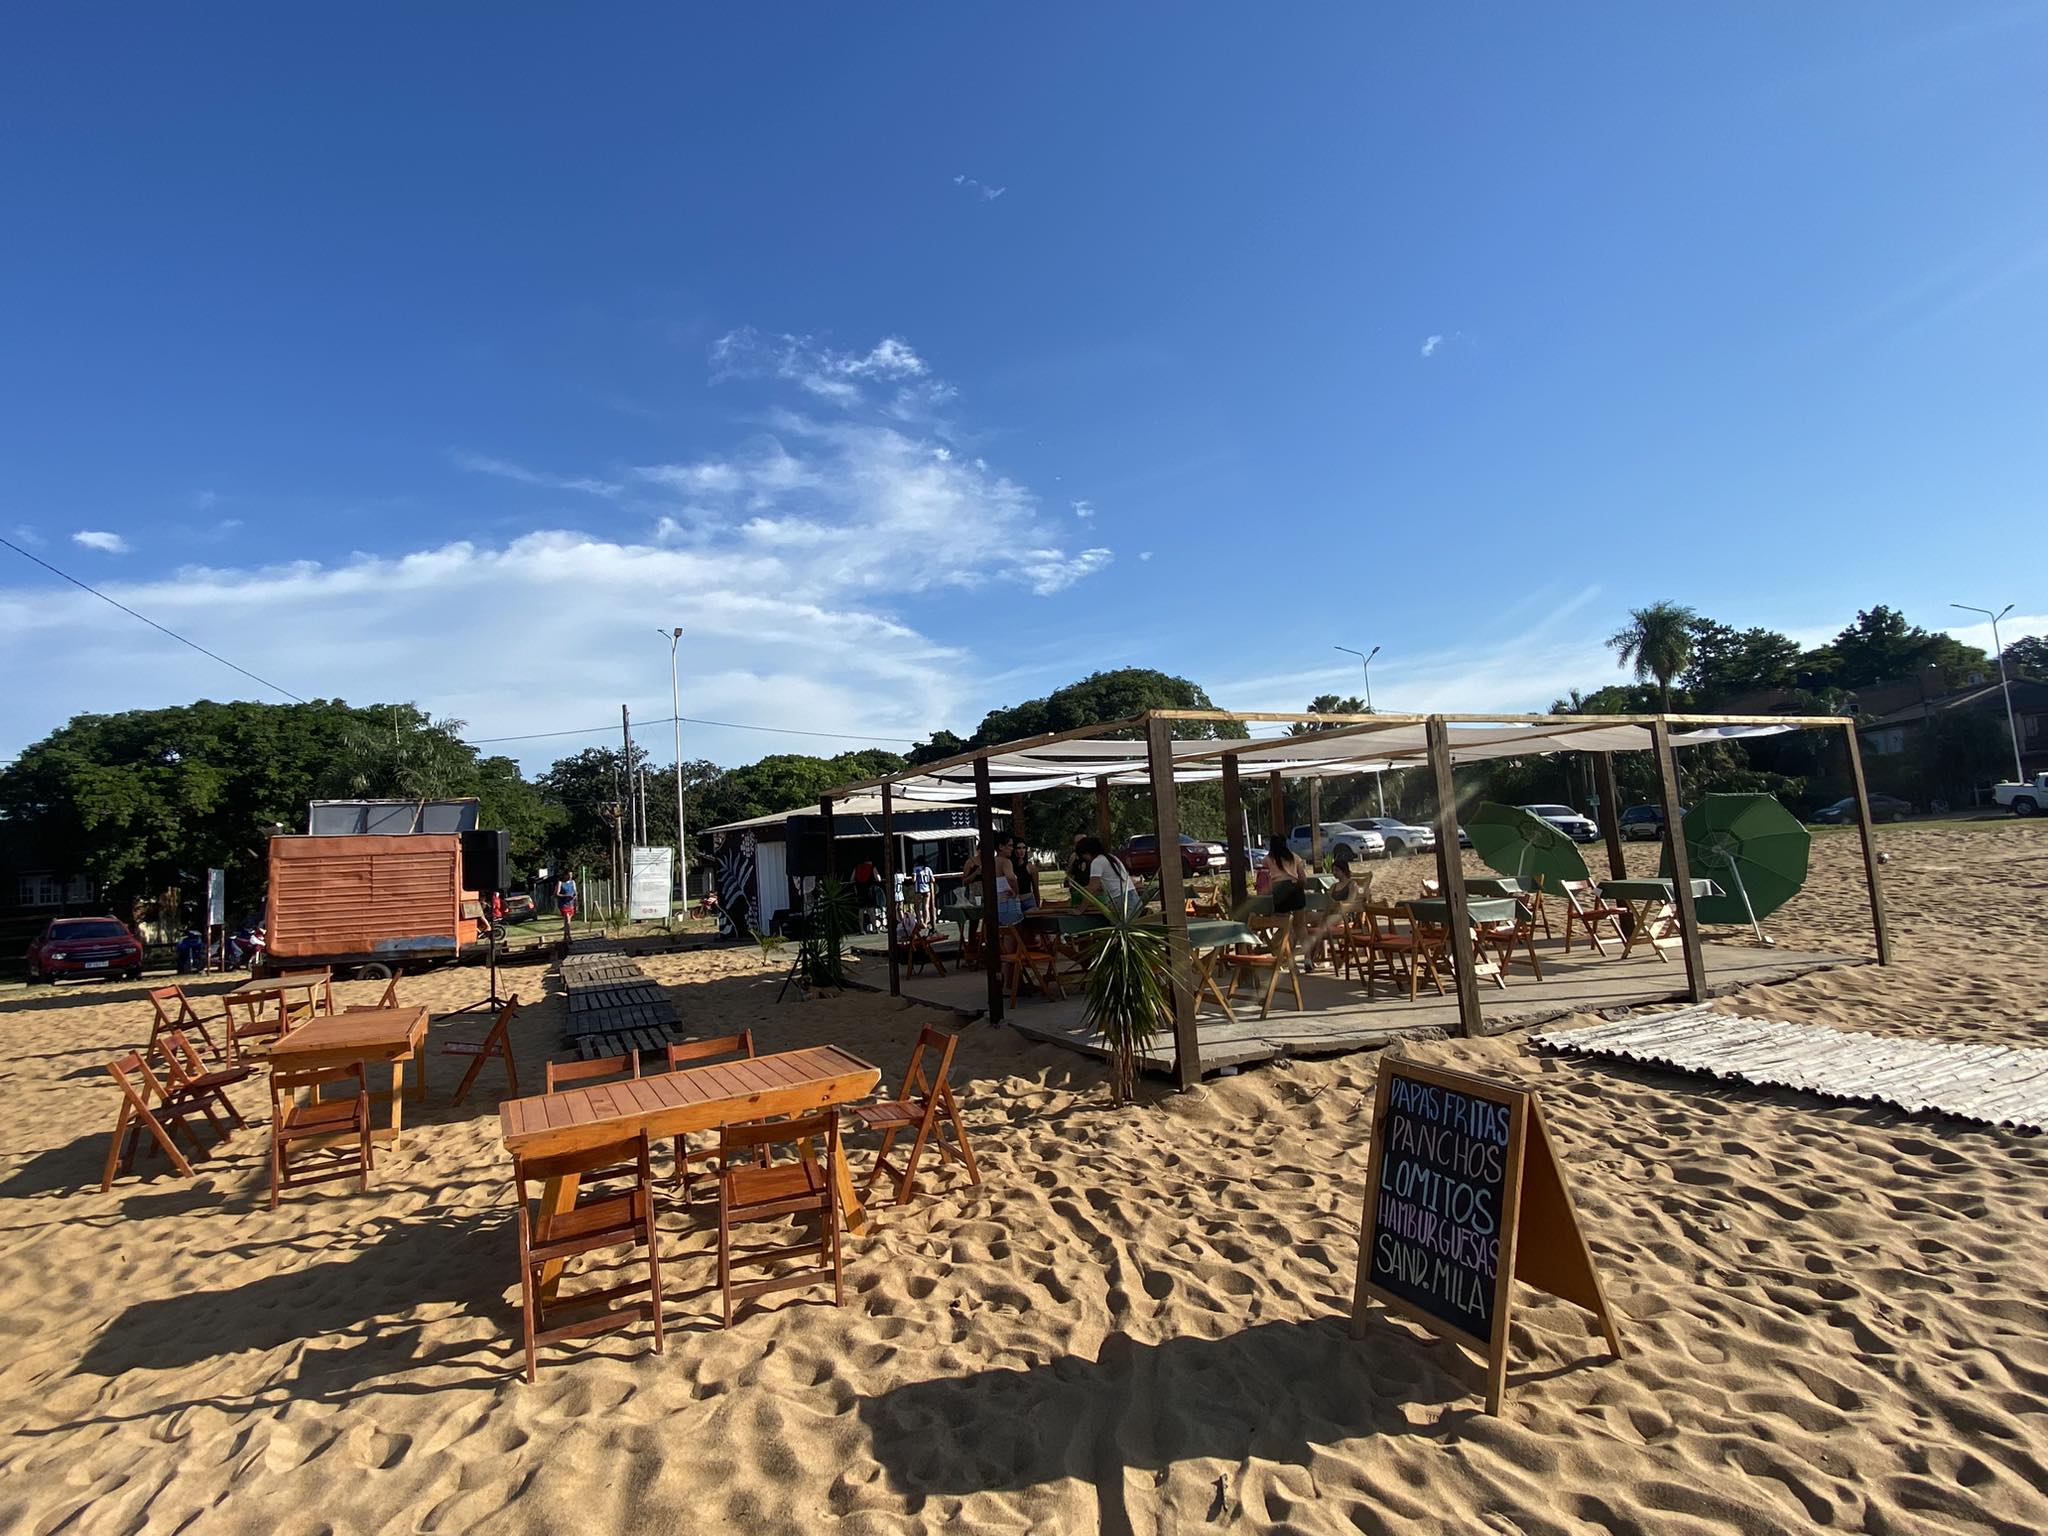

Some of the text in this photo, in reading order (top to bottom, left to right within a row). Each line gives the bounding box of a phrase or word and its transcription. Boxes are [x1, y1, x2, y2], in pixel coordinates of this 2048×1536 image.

[1390, 1077, 1511, 1146] PAPAS FRITAS
[1391, 1115, 1502, 1183] PANCHOS
[1381, 1154, 1495, 1235] LOMITOS
[1376, 1233, 1487, 1320] SAND. MILA
[1378, 1193, 1501, 1279] HAMBURGUESAS
